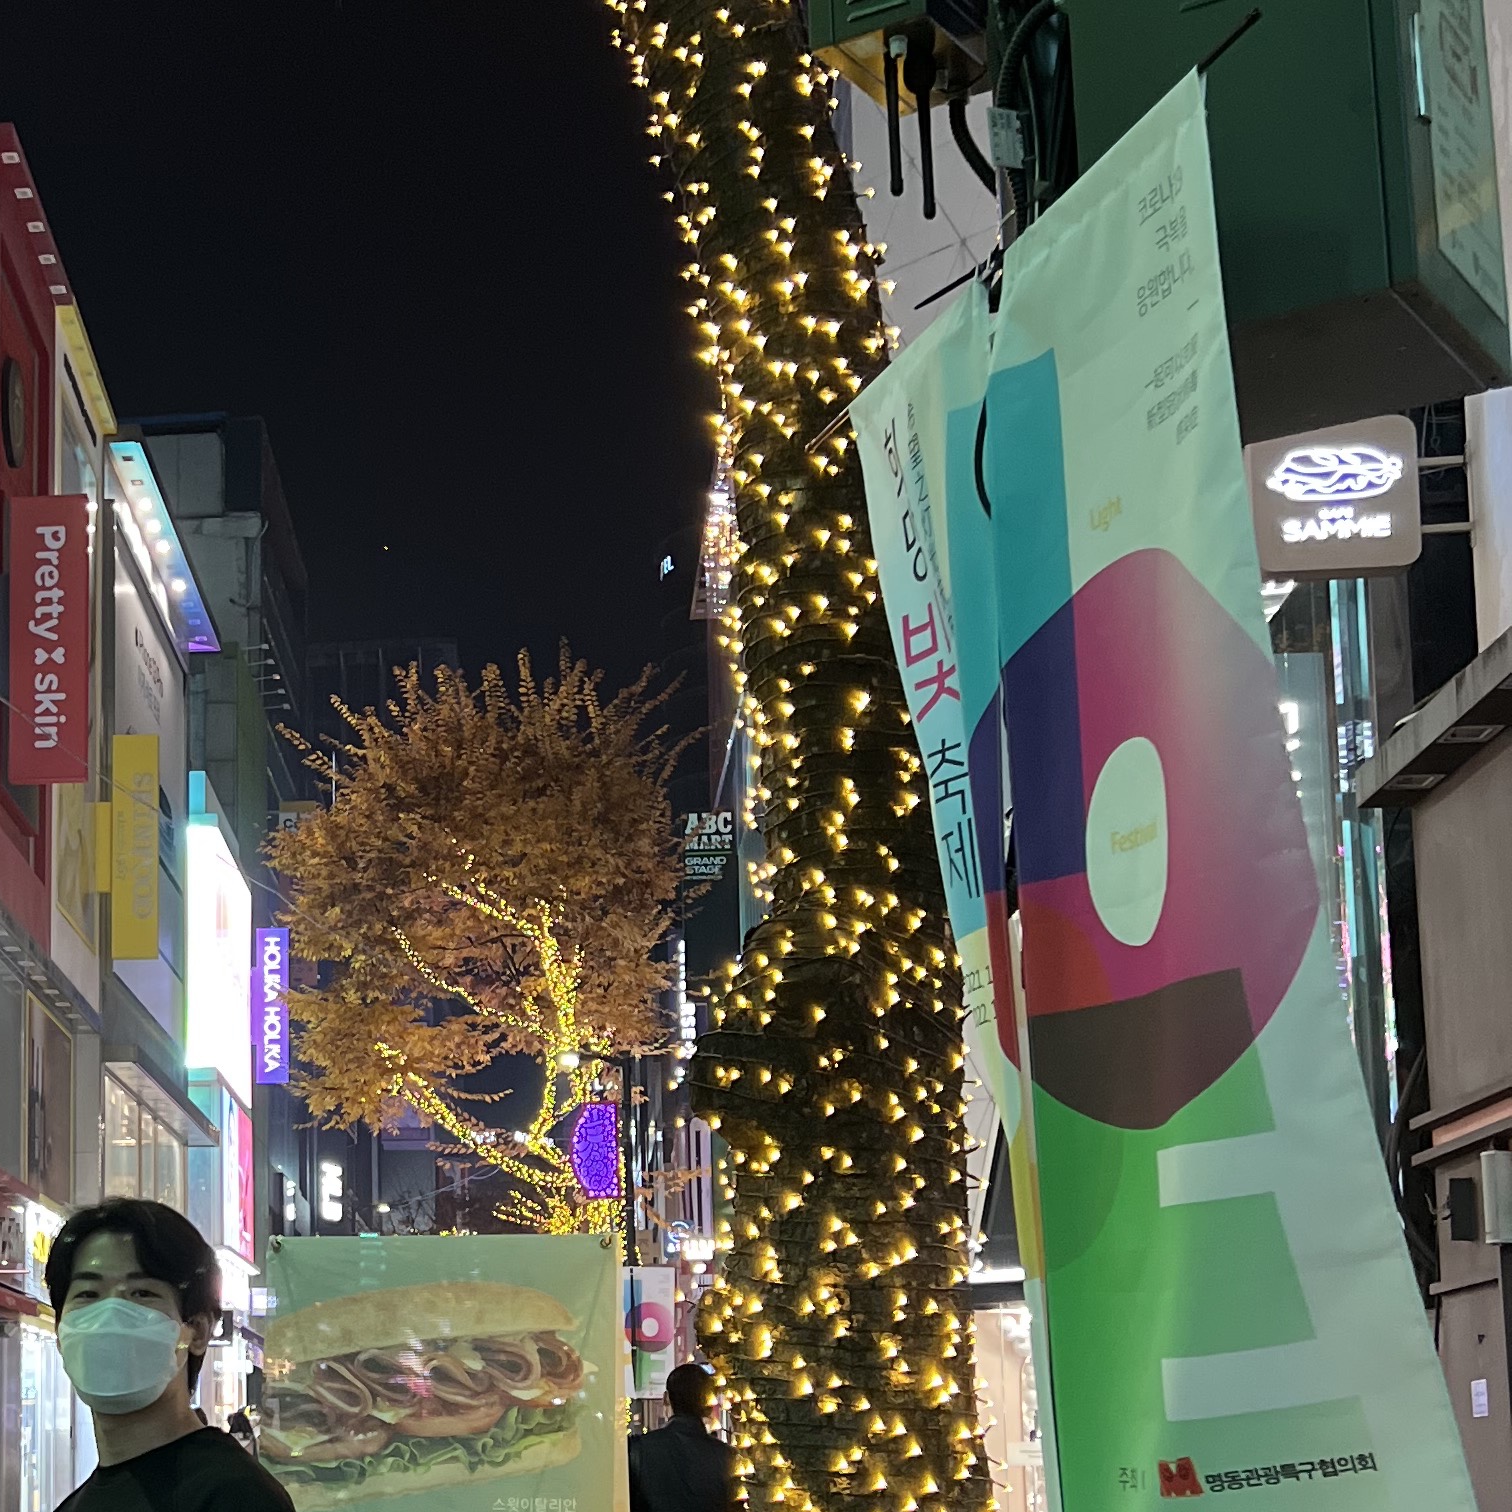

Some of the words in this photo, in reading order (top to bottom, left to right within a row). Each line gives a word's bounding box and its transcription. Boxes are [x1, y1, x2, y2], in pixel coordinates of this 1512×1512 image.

[1281, 512, 1393, 543] SAMMIE
[28, 525, 66, 642] Pretty
[902, 602, 961, 723] 빛
[33, 672, 67, 750] skin
[684, 834, 733, 850] MART
[685, 811, 733, 834] ABC
[927, 738, 981, 899] 축제
[685, 856, 728, 866] GRAND
[263, 936, 282, 1003] HOLIKA
[263, 1006, 282, 1074] HOLIKA
[1205, 1452, 1379, 1493] 명동관광특구협의회
